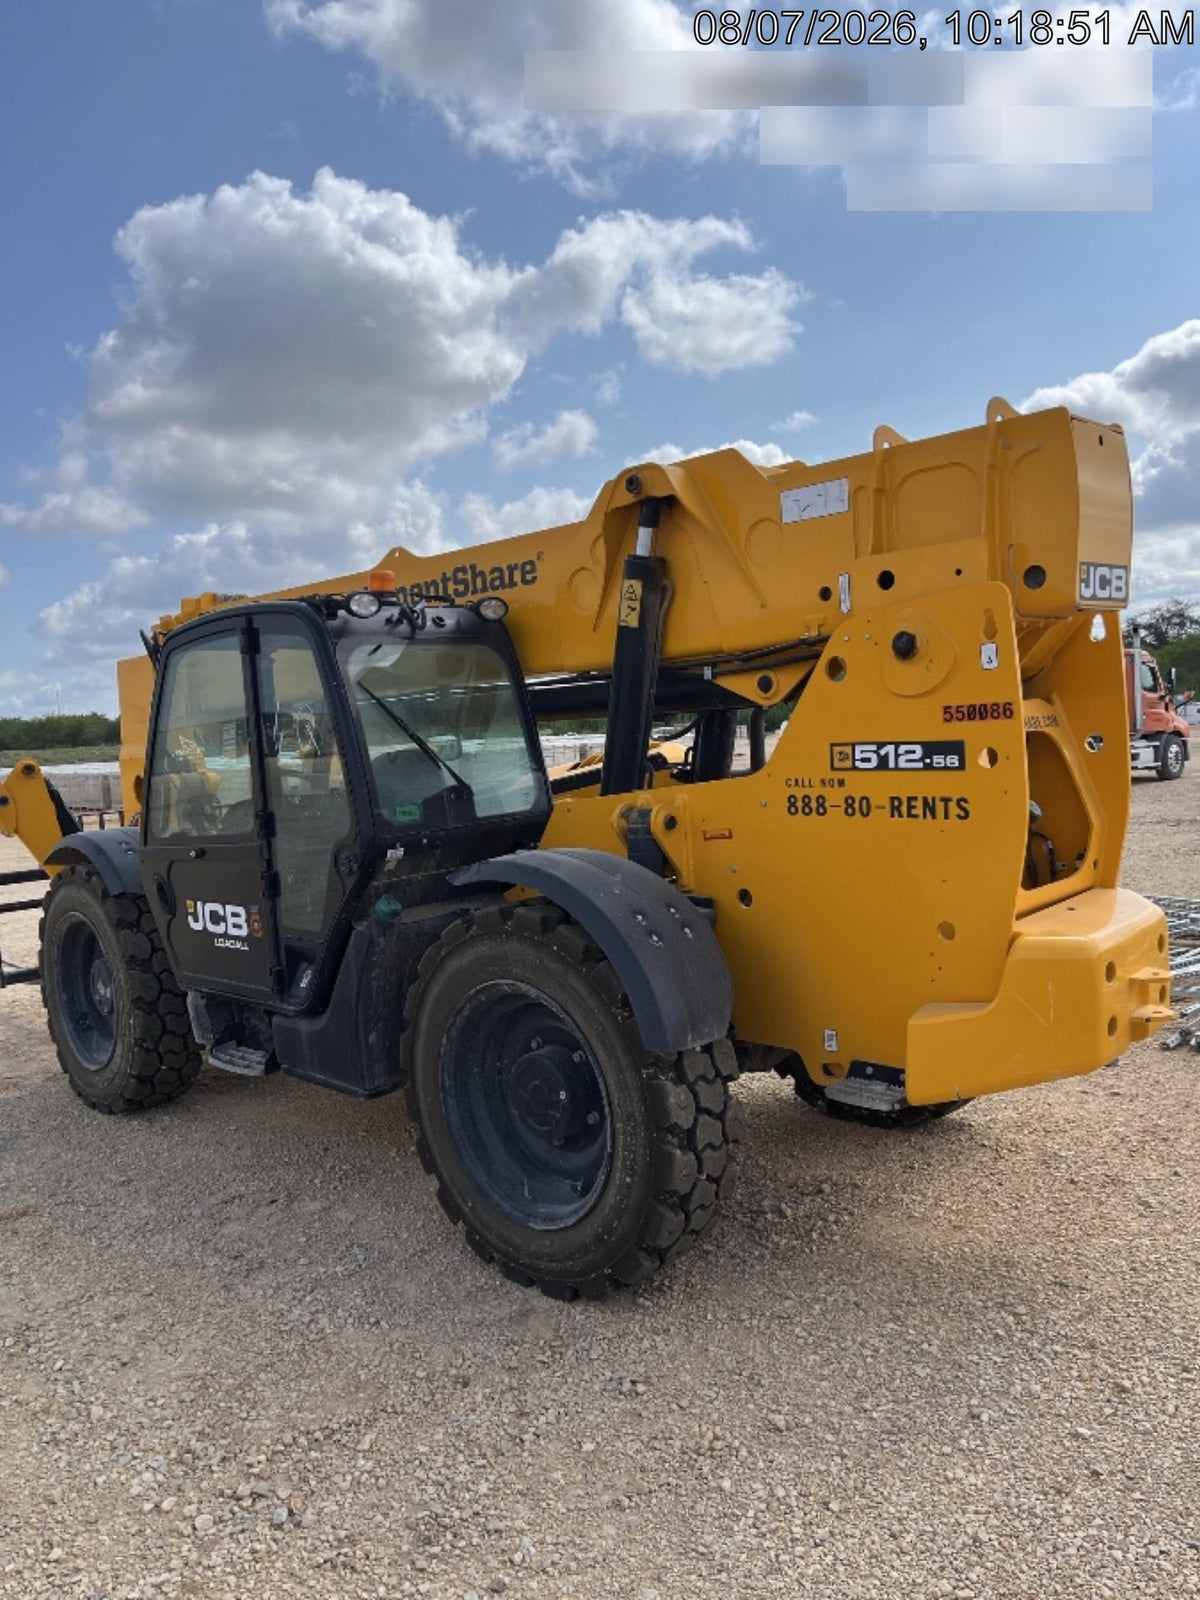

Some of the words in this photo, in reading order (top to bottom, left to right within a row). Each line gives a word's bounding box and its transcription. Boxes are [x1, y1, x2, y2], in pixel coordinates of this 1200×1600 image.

[1080, 565, 1127, 599] JCB
[943, 702, 1014, 722] 550086
[785, 778, 815, 788] CALL
[820, 778, 846, 788] NOW
[786, 794, 971, 820] 888-80-RENTS
[187, 900, 248, 937] JCB
